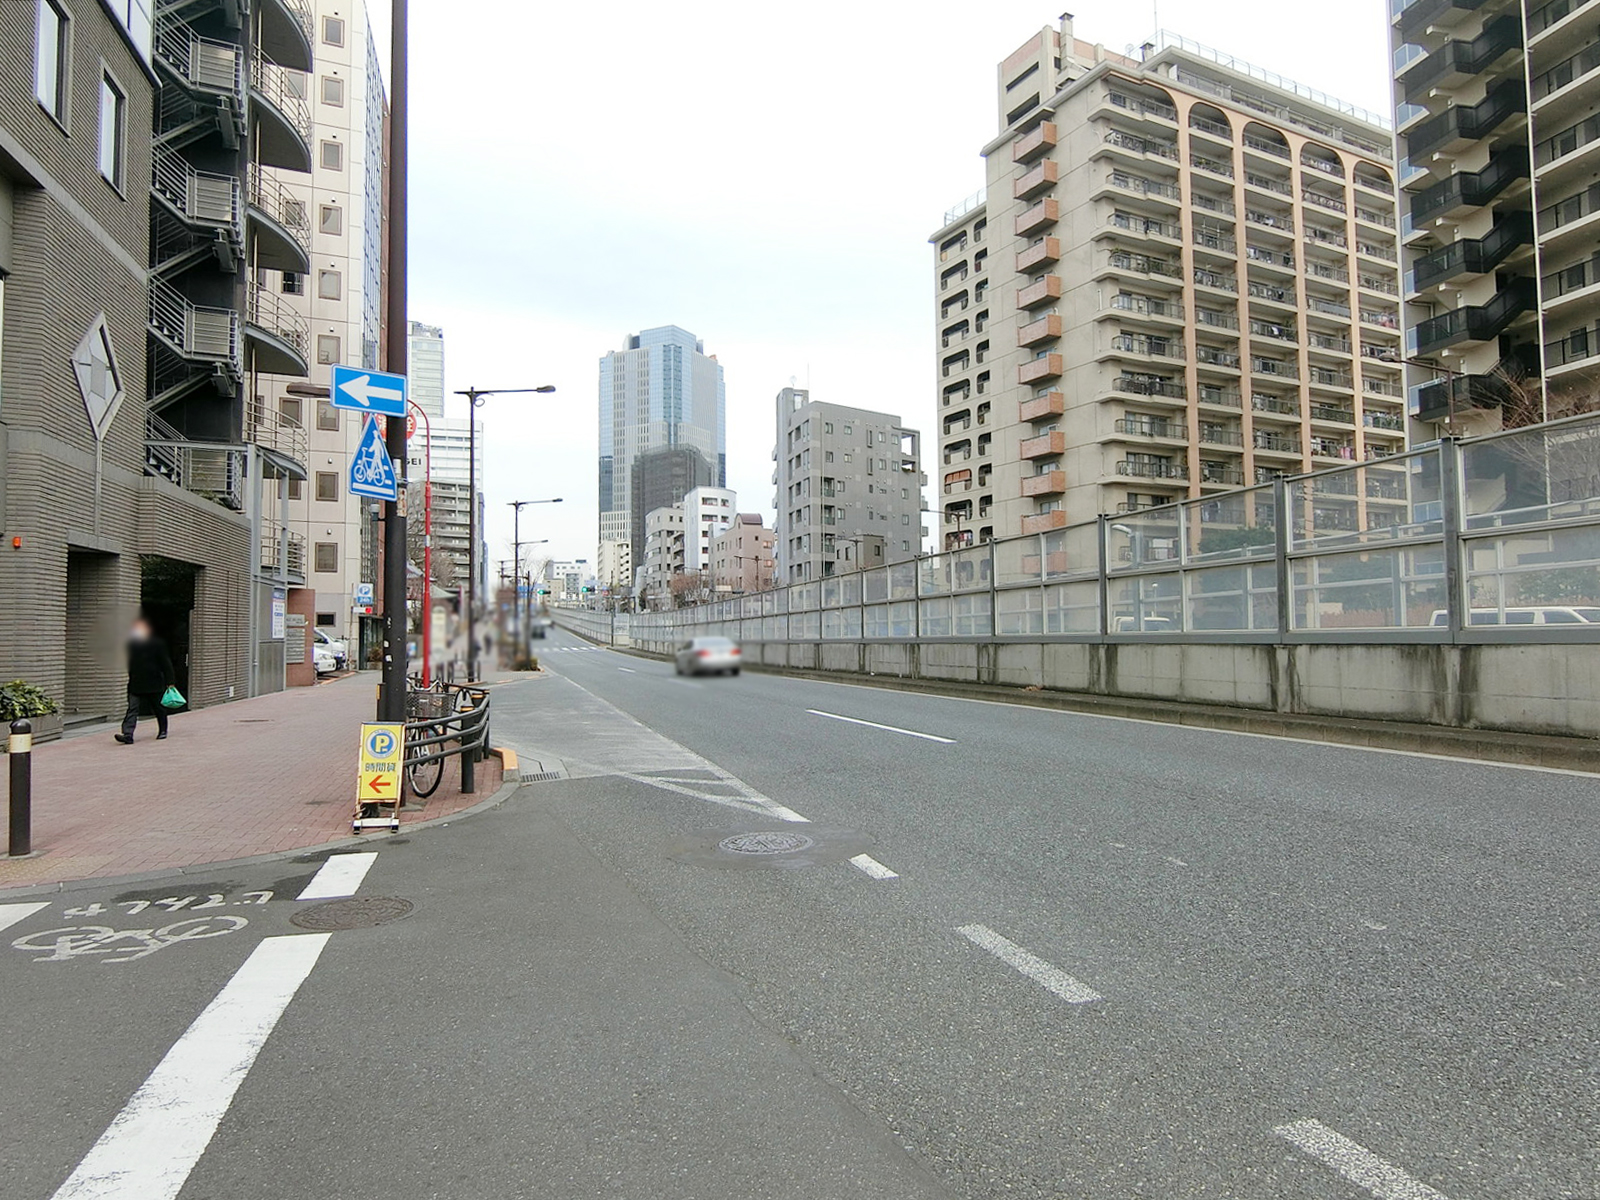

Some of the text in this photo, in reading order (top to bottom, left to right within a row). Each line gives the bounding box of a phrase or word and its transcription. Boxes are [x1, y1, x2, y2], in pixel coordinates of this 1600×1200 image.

[64, 890, 274, 918] じてんしゃ
